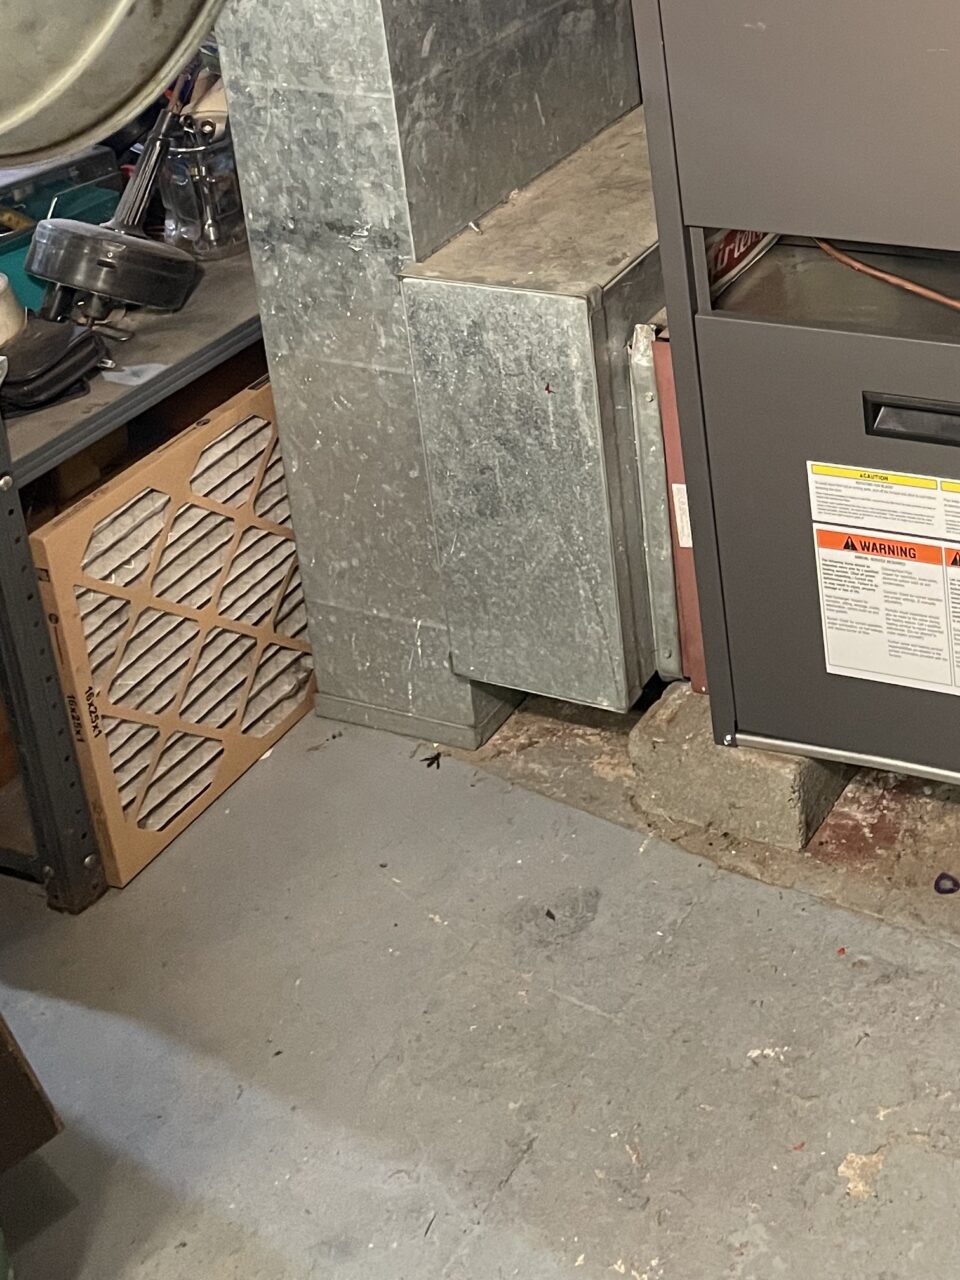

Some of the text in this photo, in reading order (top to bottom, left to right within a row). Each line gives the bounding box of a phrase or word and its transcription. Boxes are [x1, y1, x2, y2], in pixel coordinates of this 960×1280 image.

[863, 473, 889, 481] CAUTION
[859, 540, 917, 559] WARNING
[66, 695, 85, 743] 16x25x1
[84, 686, 102, 738] 16x25x1
